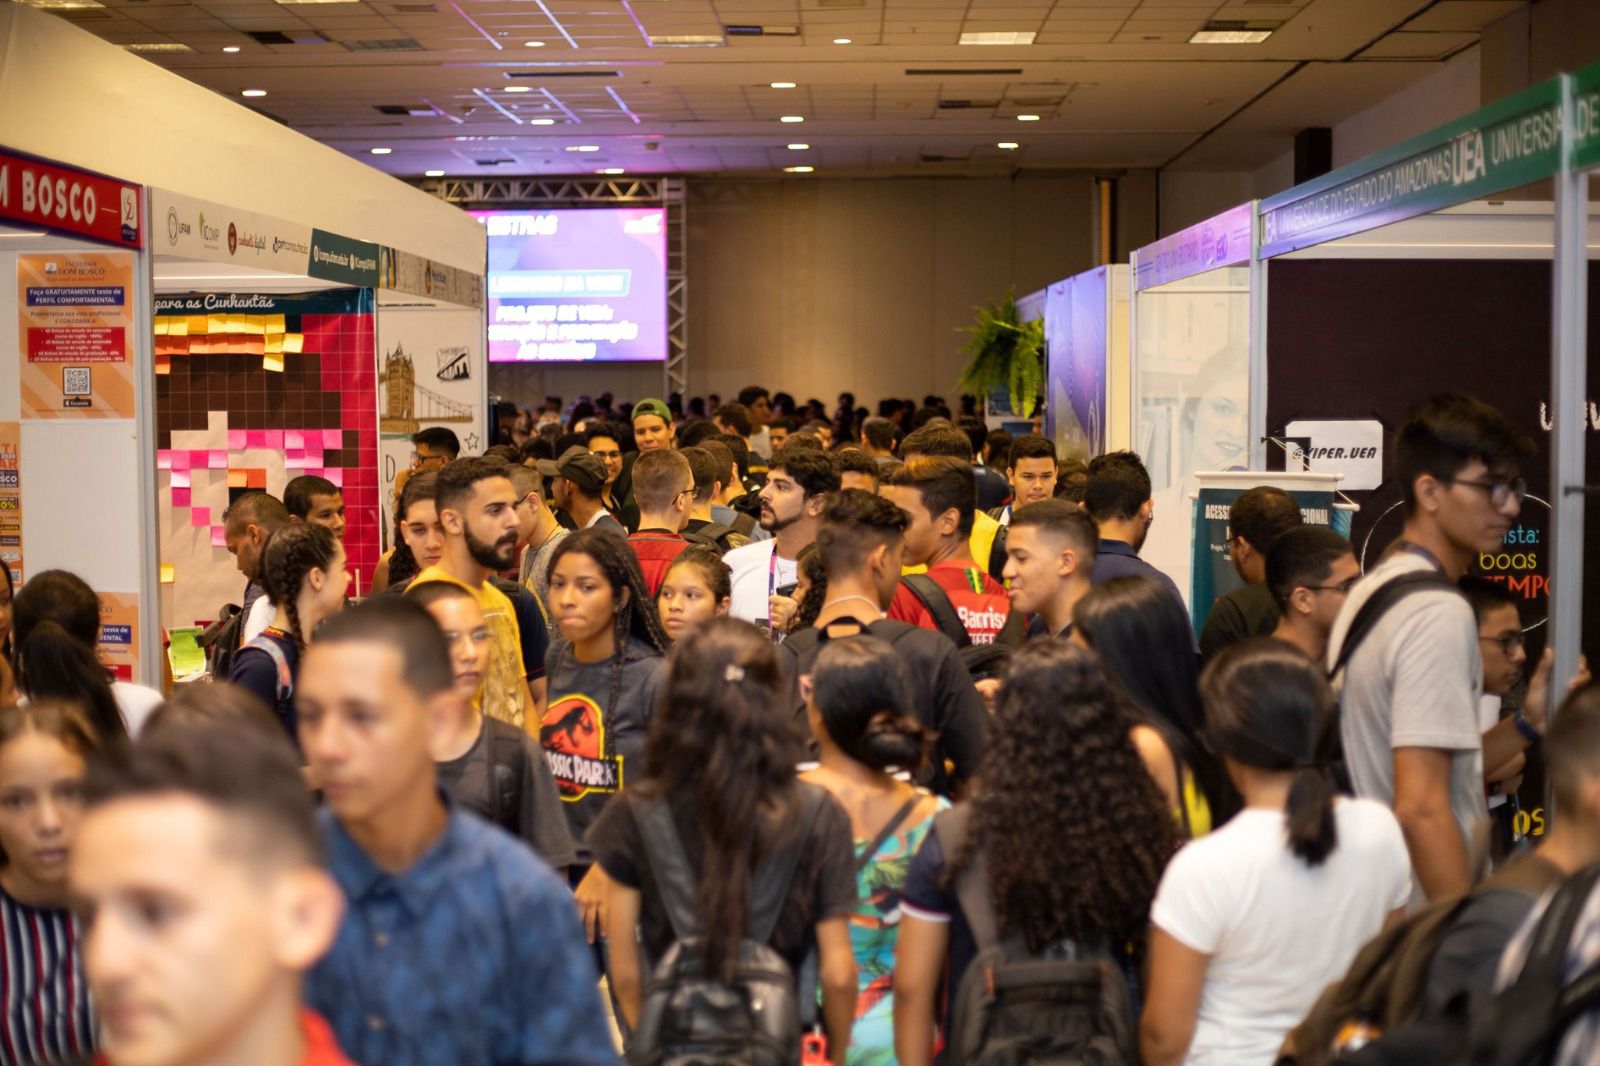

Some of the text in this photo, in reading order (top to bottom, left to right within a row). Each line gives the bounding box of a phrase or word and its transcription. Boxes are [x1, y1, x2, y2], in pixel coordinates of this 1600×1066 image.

[1452, 129, 1486, 186] UEA
[1330, 193, 1344, 219] DO
[1345, 178, 1378, 214] ESTADO
[1378, 174, 1394, 203] DO
[1395, 149, 1451, 199] AMAZONAS
[22, 170, 97, 225] BOSCO
[58, 267, 105, 275] DOM BOSCO
[29, 288, 44, 297] Faça
[154, 294, 275, 314] para as Cunhantãs
[1479, 552, 1537, 570] boas
